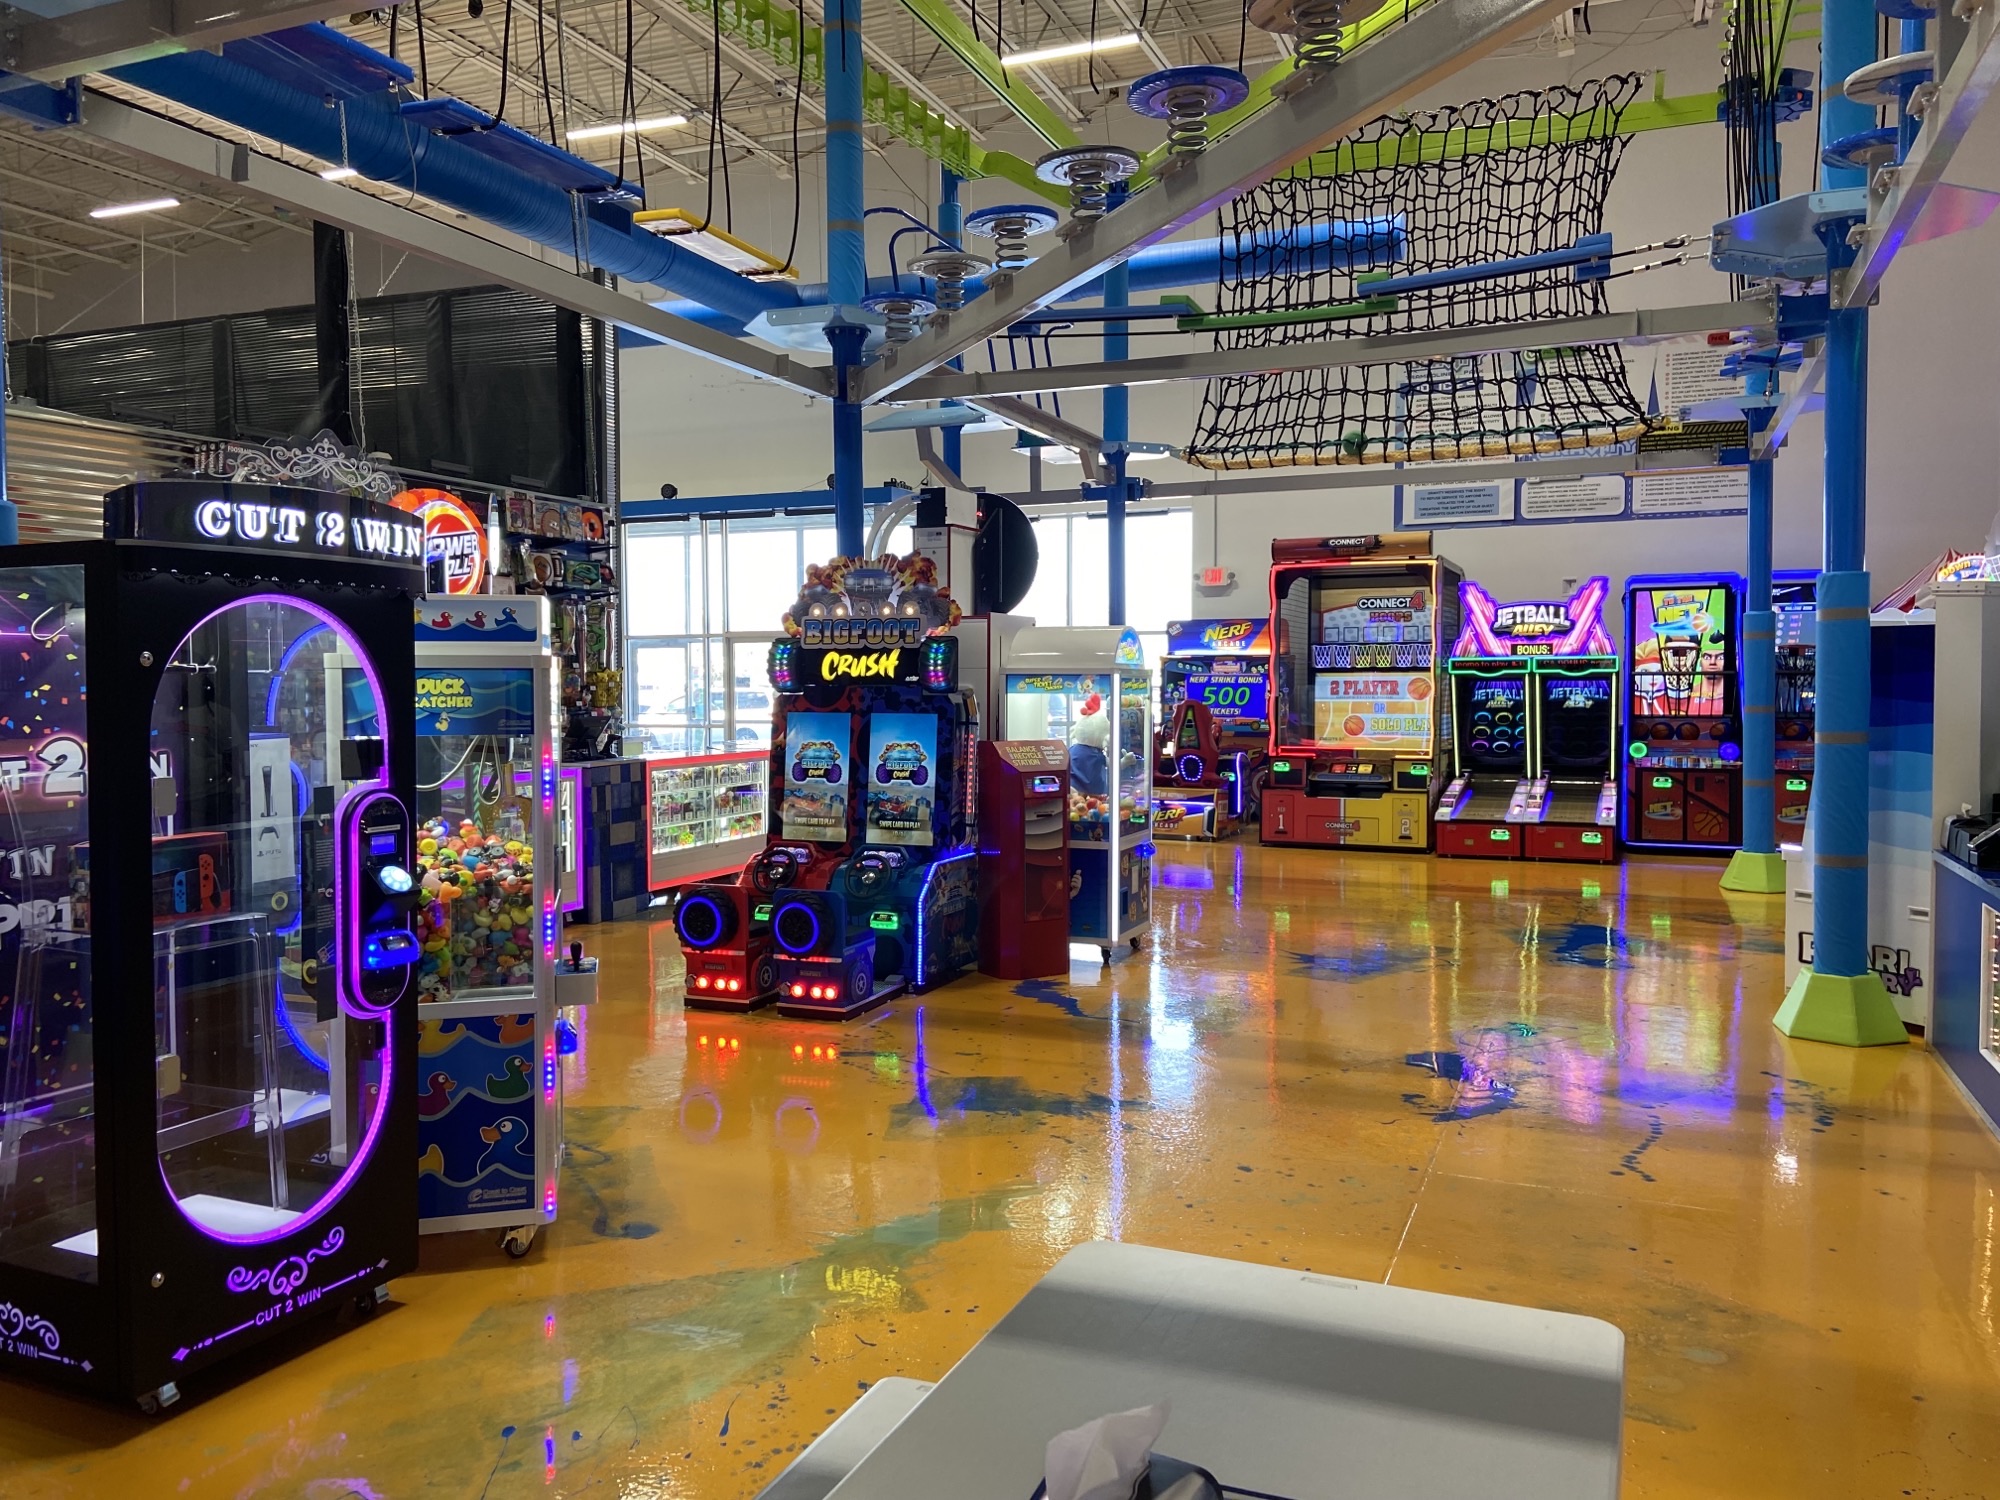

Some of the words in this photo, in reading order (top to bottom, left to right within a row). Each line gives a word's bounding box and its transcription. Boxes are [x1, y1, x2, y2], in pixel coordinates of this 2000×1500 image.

[196, 500, 305, 543] CUT
[316, 511, 345, 547] 2
[351, 517, 422, 558] WIN
[428, 533, 478, 556] OWER
[1329, 538, 1365, 546] CONNECT
[1358, 598, 1411, 609] CONNECT
[1409, 591, 1425, 610] 4
[1493, 604, 1571, 628] JETBALL
[804, 618, 920, 645] BIGFOOT
[1203, 622, 1252, 642] NERF
[1511, 624, 1555, 636] ALLEY
[1516, 645, 1550, 655] BONUS:
[821, 648, 901, 681] CRUSH
[416, 677, 465, 695] DUCK
[1189, 676, 1208, 684] NERF
[1210, 676, 1236, 684] STRIKE
[1238, 676, 1263, 684] BONUS
[1330, 680, 1340, 695] 2
[1343, 680, 1399, 695] PLAYER
[415, 695, 474, 708] ATCHER
[1202, 686, 1251, 706] 500
[1373, 702, 1386, 713] OR
[1371, 717, 1400, 731] SOLO
[1404, 717, 1431, 731] PLA
[1005, 745, 1037, 753] BALANCE
[38, 738, 85, 795] 2
[0, 845, 56, 880] IN
[256, 1303, 282, 1325] CUT
[285, 1299, 293, 1313] 2
[297, 1286, 321, 1307] WIN
[8, 1339, 14, 1352] 2
[17, 1341, 38, 1358] WIN
